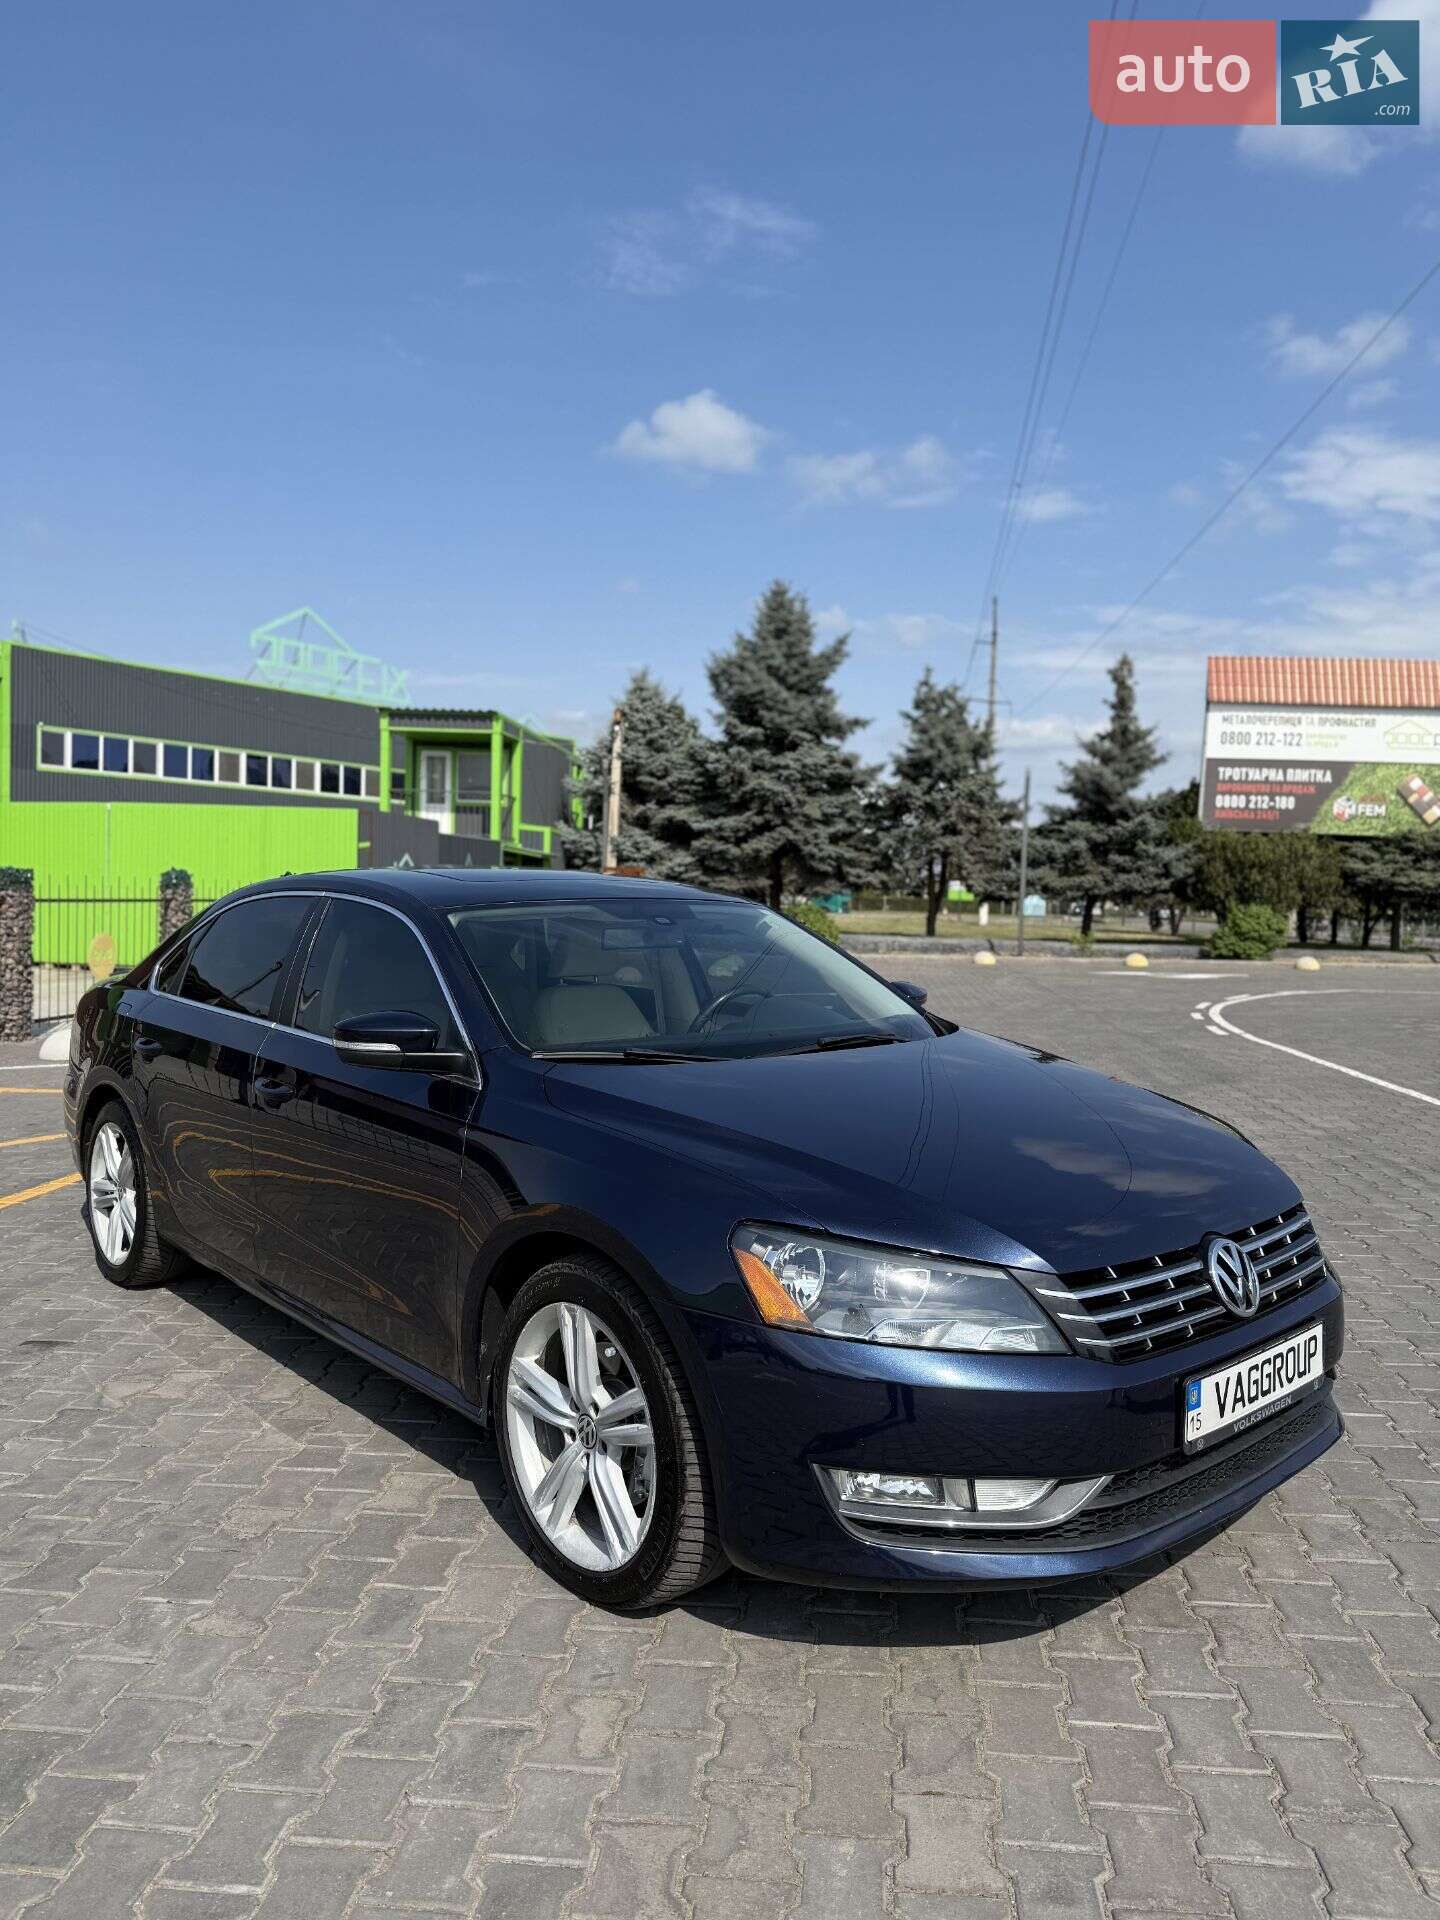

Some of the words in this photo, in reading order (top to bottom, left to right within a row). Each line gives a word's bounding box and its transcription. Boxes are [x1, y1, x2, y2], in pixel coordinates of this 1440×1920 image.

[1220, 731, 1252, 745] 0800
[1256, 732, 1303, 747] 212-122
[1217, 767, 1284, 782] ТРОТУАРНА
[1286, 768, 1332, 783] ПЛИТКА
[1215, 794, 1246, 808] 0800
[1215, 1335, 1318, 1419] VAGGROUP
[1190, 1412, 1202, 1434] 15
[1233, 1397, 1292, 1433] VOLKSWAGEN
